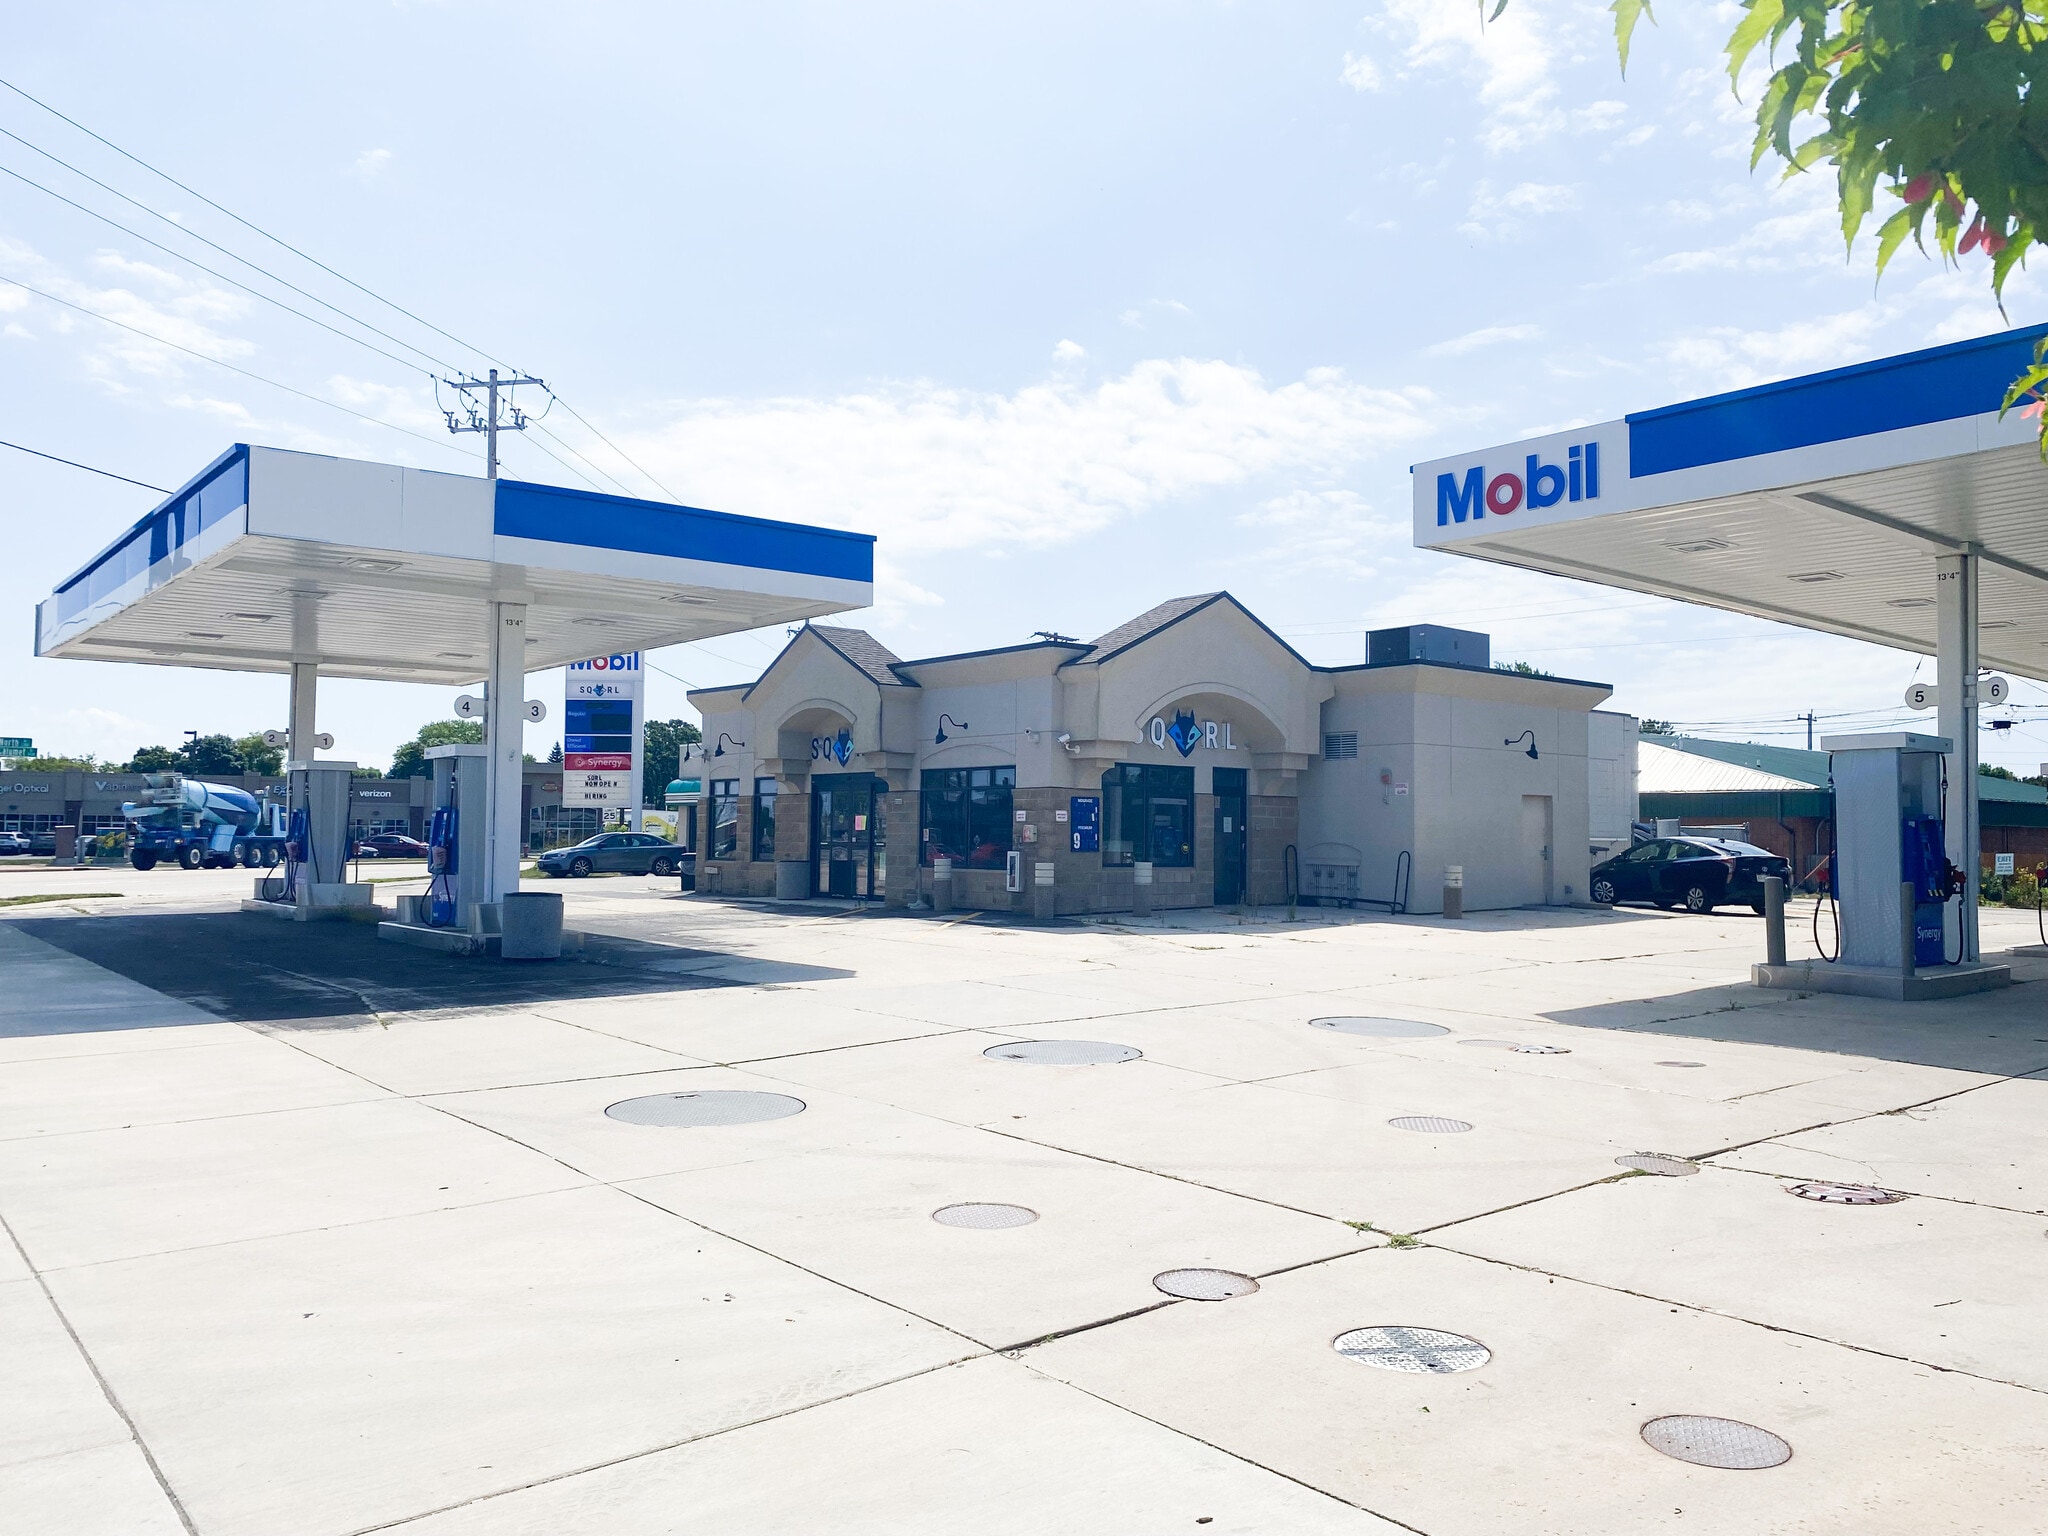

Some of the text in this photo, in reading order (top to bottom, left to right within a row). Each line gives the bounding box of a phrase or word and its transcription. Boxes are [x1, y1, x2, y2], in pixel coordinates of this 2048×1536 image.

[1437, 442, 1600, 527] Mobil
[1937, 571, 1960, 581] 13'4"
[505, 618, 523, 626] 13'4"
[1991, 684, 2000, 697] 6
[1914, 690, 1925, 703] 5
[462, 701, 470, 712] 4
[531, 705, 539, 716] 3
[269, 734, 275, 743] 2
[323, 737, 328, 746] 1
[587, 758, 622, 768] Synergy
[13, 783, 49, 794] Optical
[359, 789, 391, 798] verizon
[603, 812, 616, 820] 25
[1073, 832, 1081, 849] 9
[438, 891, 456, 905] Synegy
[1917, 926, 1942, 942] Synergy
